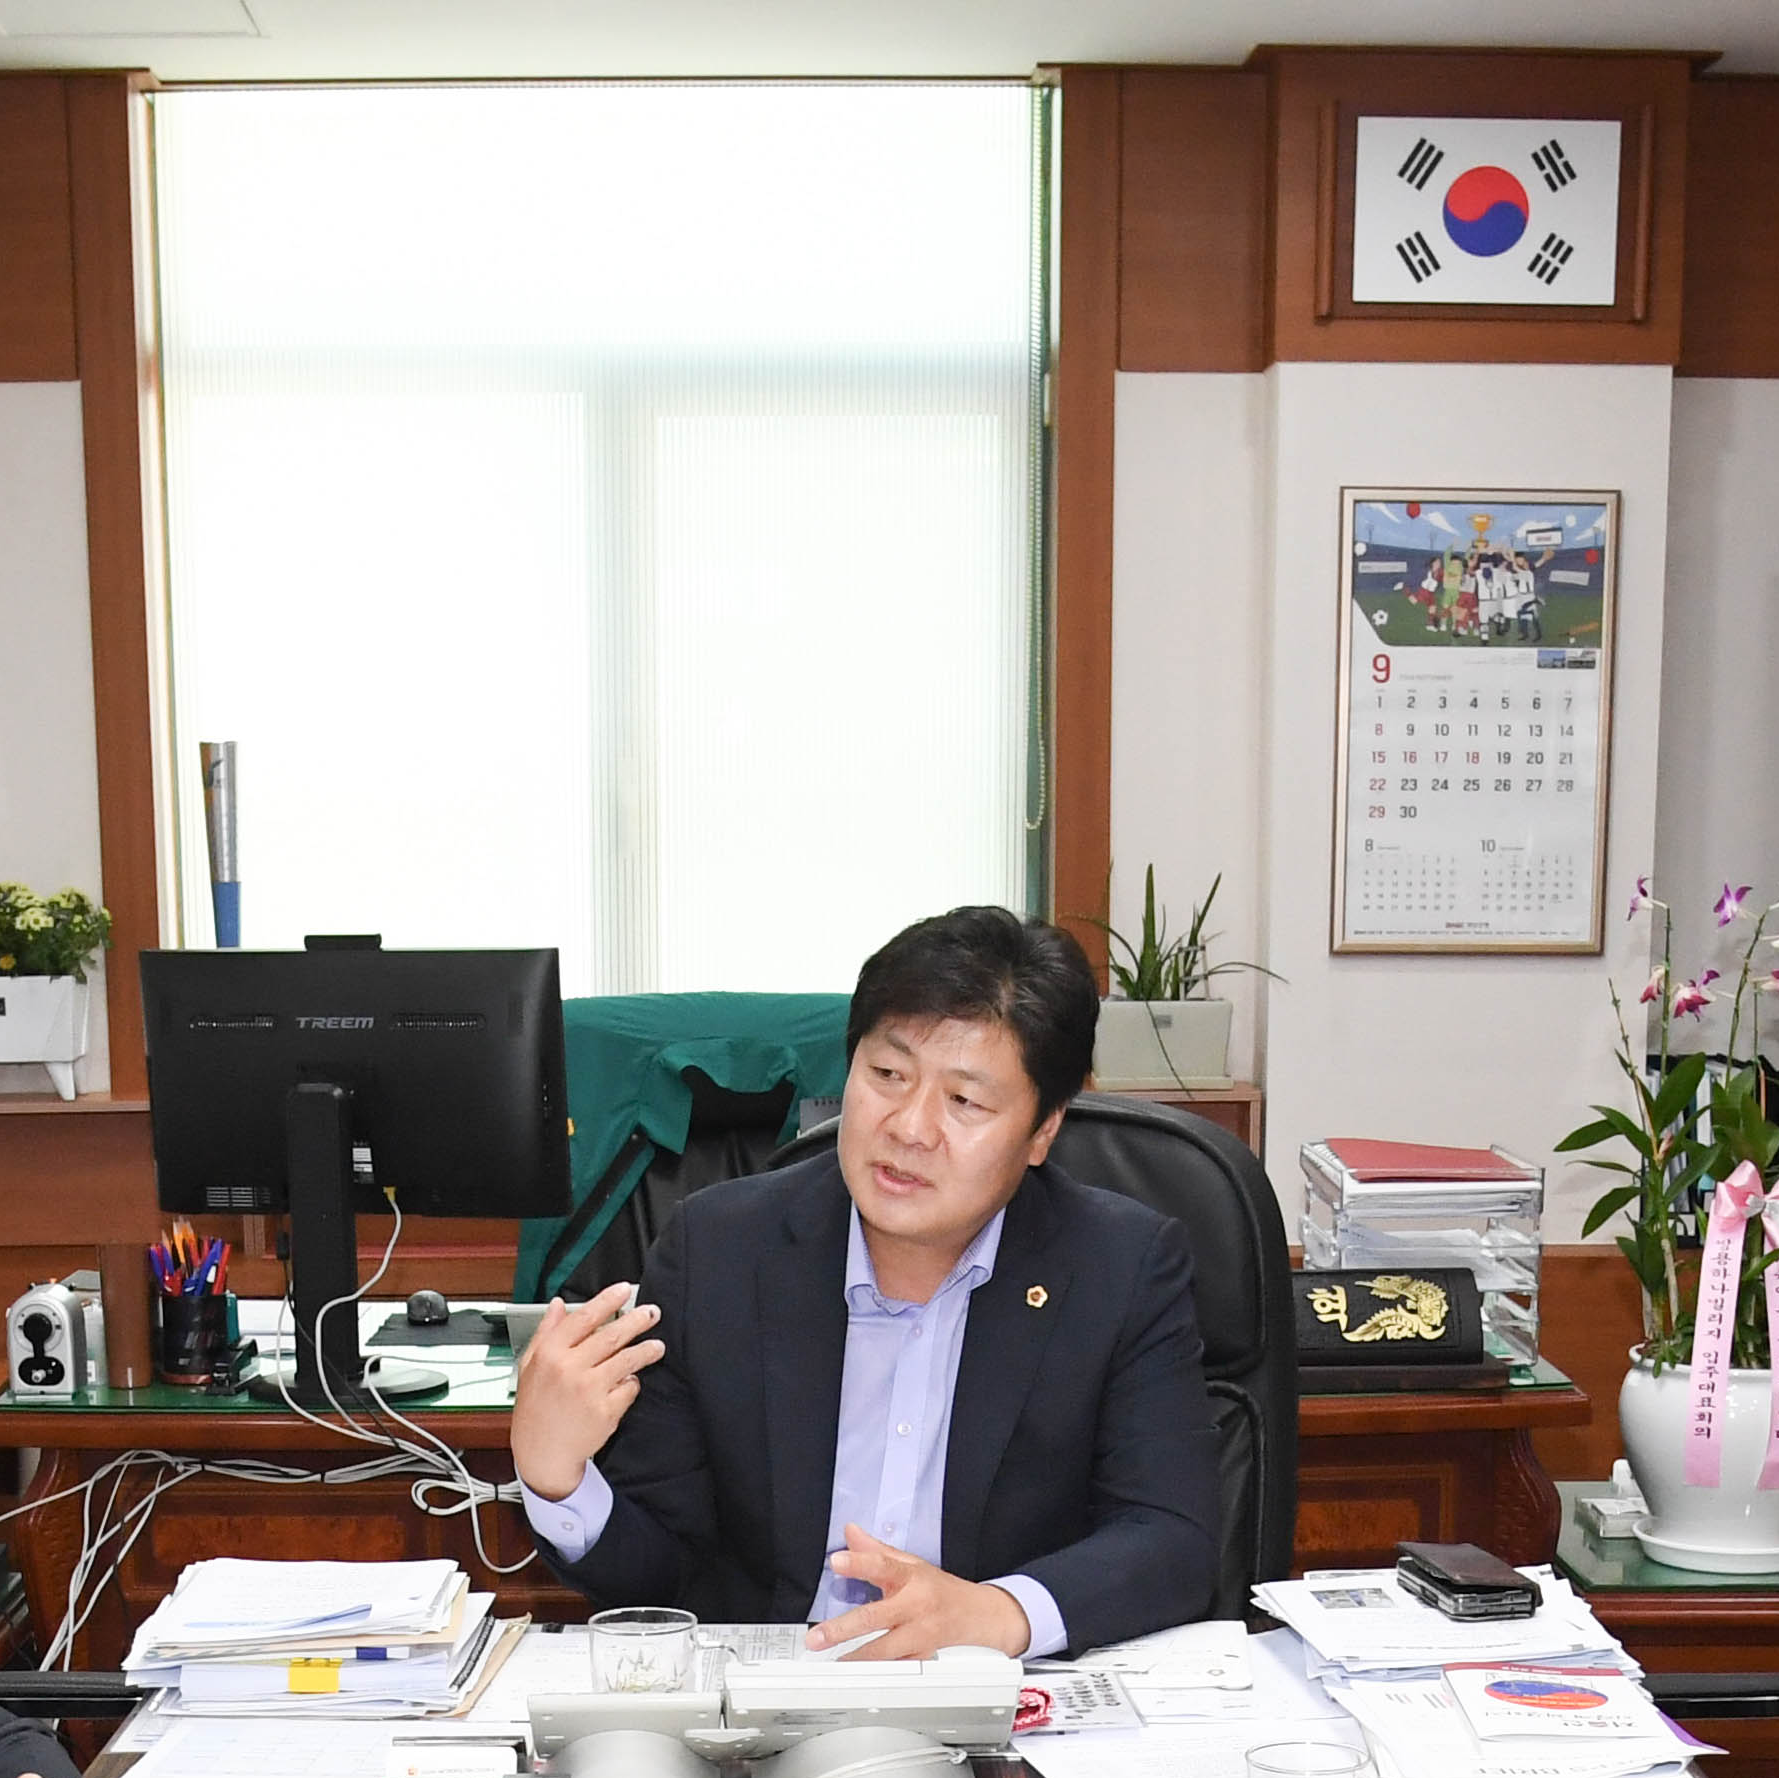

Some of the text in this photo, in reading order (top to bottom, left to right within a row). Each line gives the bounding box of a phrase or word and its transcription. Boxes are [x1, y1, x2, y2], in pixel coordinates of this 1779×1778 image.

[1372, 653, 1392, 683] 9
[1377, 696, 1572, 710] 1 2 3 4 5 6 7
[1374, 723, 1574, 737] 8 9 10 11 12 13 14
[1372, 751, 1573, 764] 15 16 17 18 19 20 21
[1369, 779, 1574, 792] 22 23 24 25 26 27 28
[1368, 806, 1417, 819] 29 30
[1365, 838, 1374, 852] 8
[1481, 840, 1497, 853] 10
[295, 1016, 375, 1030] TREEM
